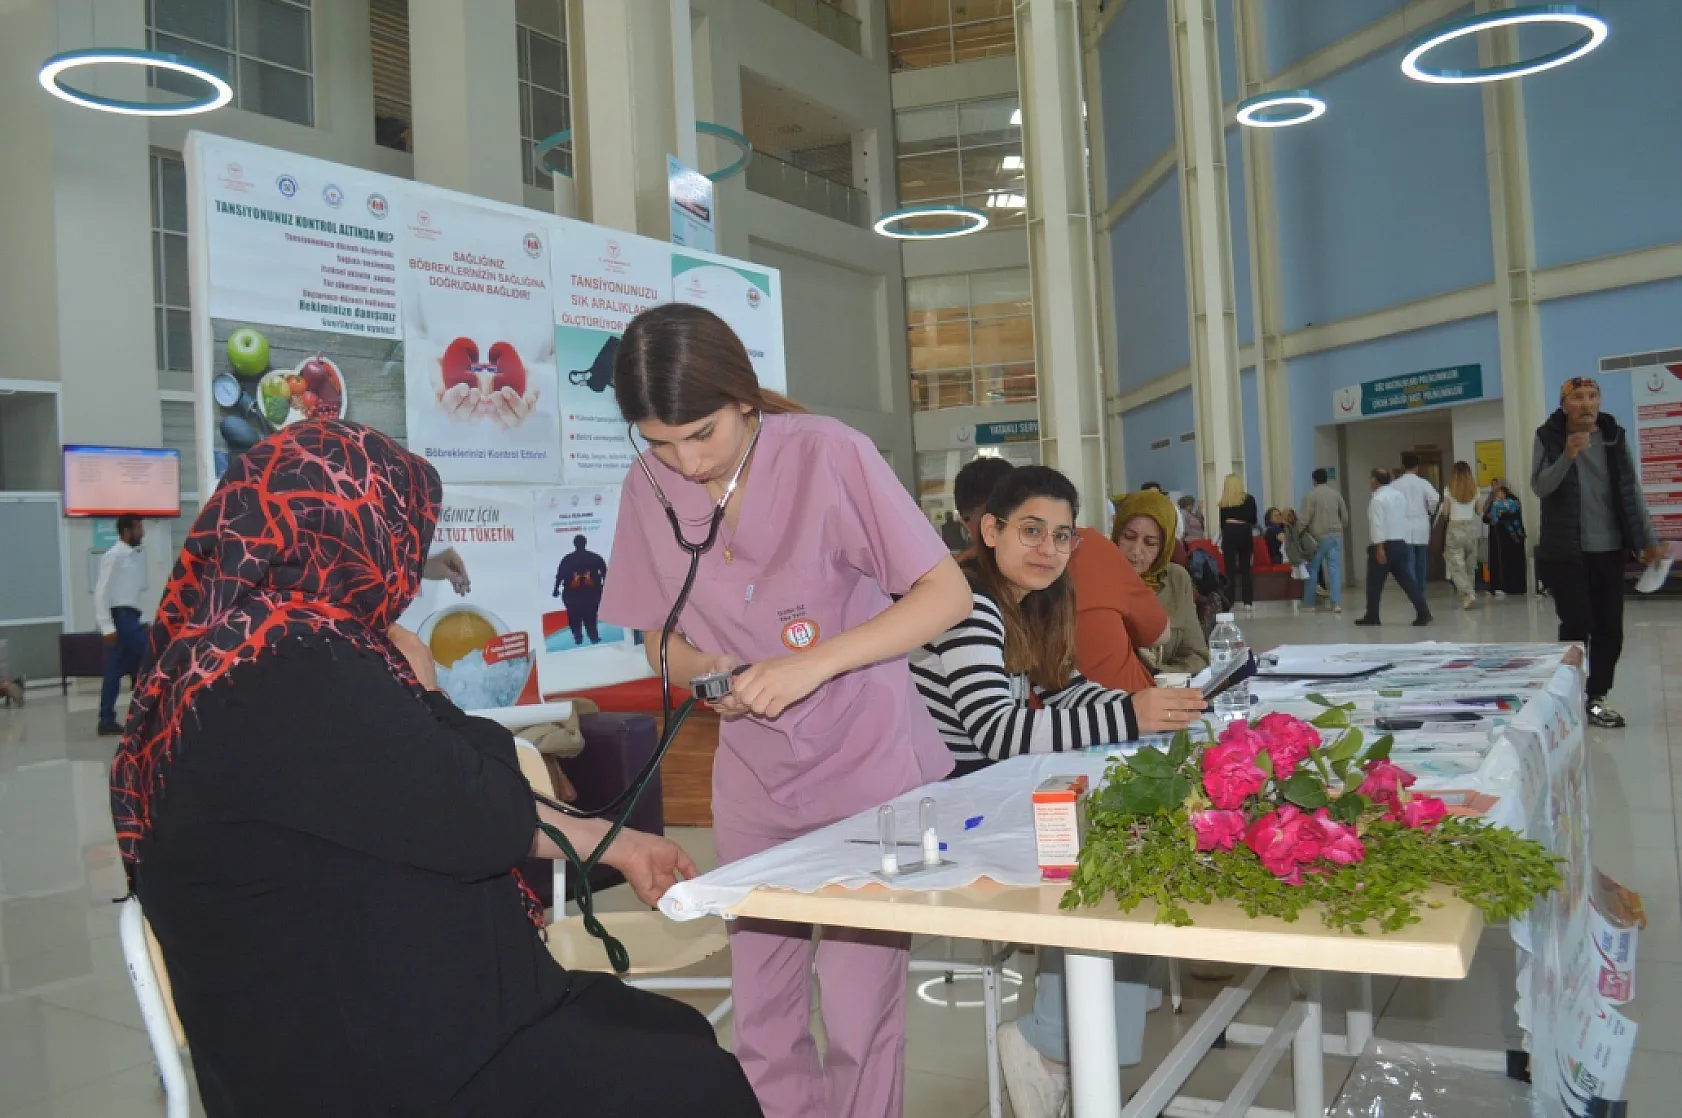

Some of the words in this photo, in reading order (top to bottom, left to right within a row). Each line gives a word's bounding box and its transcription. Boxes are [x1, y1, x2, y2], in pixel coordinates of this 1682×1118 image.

[295, 215, 338, 234] KONTROL
[429, 275, 485, 293] DOĞRUDAN
[570, 274, 658, 300] TANSİYONUNUZU
[571, 294, 589, 307] SIK
[591, 297, 650, 316] ARALIKLAR
[1019, 422, 1038, 434] SERV
[439, 505, 476, 523] IĞINIZ
[447, 527, 469, 542] TUZ
[469, 524, 515, 542] TÜKETİN
